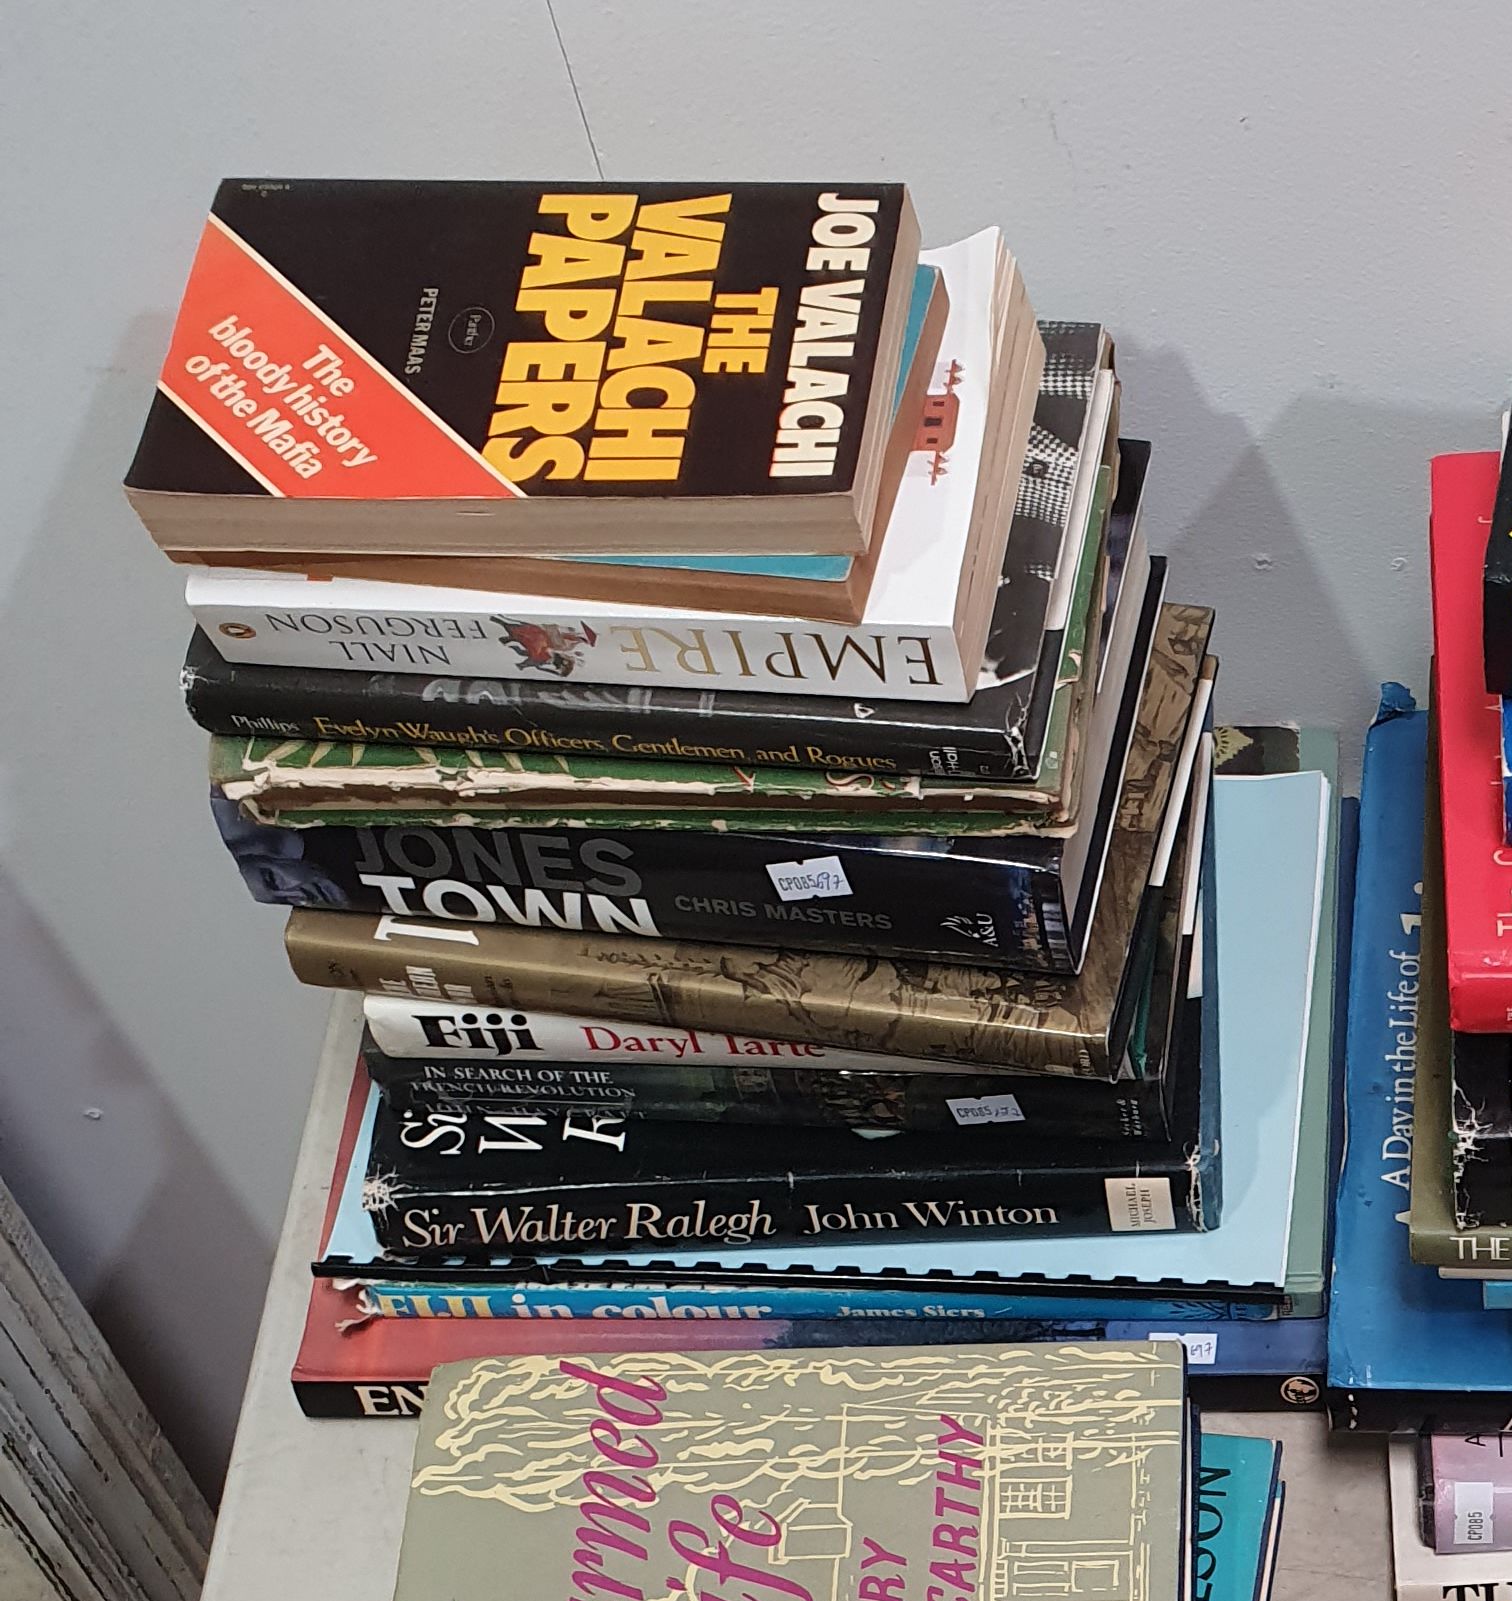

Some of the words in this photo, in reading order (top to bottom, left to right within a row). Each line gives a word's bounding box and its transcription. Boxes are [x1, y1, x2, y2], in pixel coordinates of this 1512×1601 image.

[805, 192, 880, 272] JOE
[414, 287, 439, 332] PETER
[703, 287, 779, 373] THE
[404, 333, 429, 375] MAAS
[482, 193, 639, 483] PAPERS
[584, 193, 733, 481] VALACHI
[208, 315, 296, 403] bloody
[287, 388, 378, 468] history
[301, 344, 355, 398] The
[769, 280, 865, 477] VALACHI
[185, 355, 221, 389] of
[216, 374, 258, 419] the
[246, 408, 324, 481] Mafia
[265, 613, 489, 640] FERGUSON
[328, 640, 451, 666] NIALL
[610, 626, 944, 686] EMPIRE
[231, 715, 300, 734] Phillips
[313, 716, 398, 740] Evelyn
[398, 720, 498, 746] Waugh's
[756, 744, 800, 763] and
[806, 746, 896, 771] Rogues
[353, 827, 643, 897] JONES
[359, 873, 664, 938] TOWN
[674, 893, 757, 920] CHRIS
[763, 901, 894, 931] MASTERS
[1388, 949, 1422, 977] of
[1386, 980, 1420, 1030] Life
[412, 1013, 544, 1056] Fiji
[580, 1026, 705, 1059] Daryl
[1384, 1031, 1418, 1072] the
[423, 1066, 447, 1080] IN
[454, 1067, 532, 1082] SEARCH
[537, 1069, 563, 1083] OF
[568, 1070, 614, 1085] THE
[1385, 1077, 1416, 1104] in
[1381, 1106, 1416, 1161] Day
[1380, 1164, 1411, 1192] A
[401, 1206, 464, 1248] Sir
[469, 1203, 618, 1245] Walter
[623, 1199, 778, 1244] Ralegh
[803, 1203, 901, 1236] John
[902, 1200, 1061, 1228] Winton
[1449, 1236, 1511, 1262] THE
[510, 1293, 573, 1320] in
[592, 1295, 773, 1320] colour
[836, 1304, 919, 1319] James
[1467, 1510, 1484, 1541] CP085
